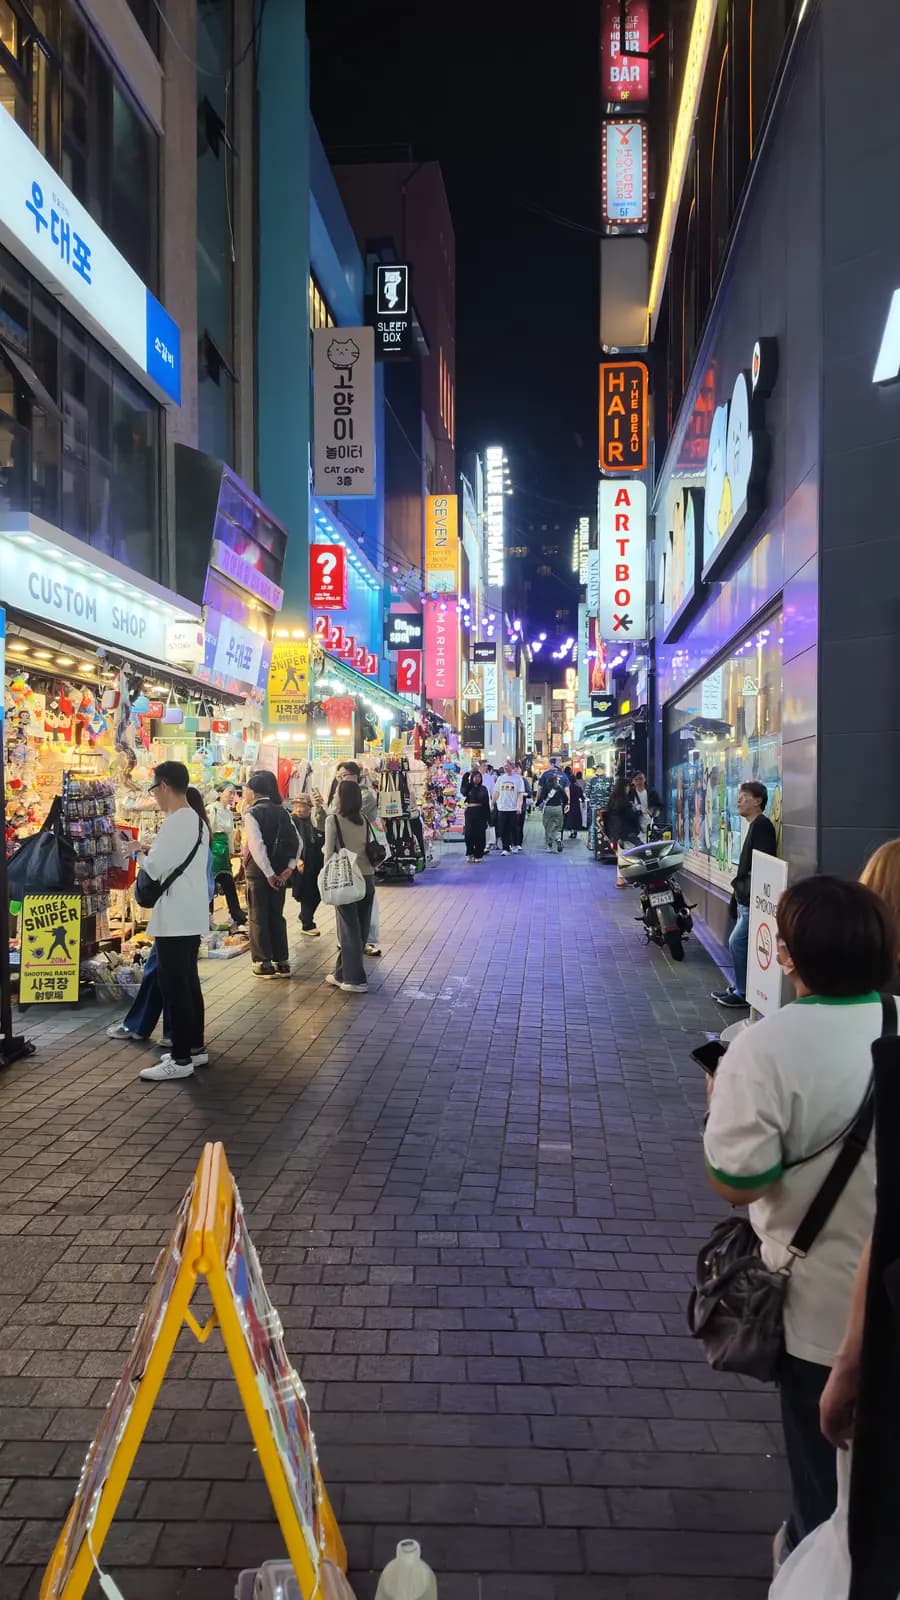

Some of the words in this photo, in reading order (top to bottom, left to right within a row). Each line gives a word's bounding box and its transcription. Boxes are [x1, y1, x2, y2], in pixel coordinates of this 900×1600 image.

[610, 65, 640, 82] BAR
[620, 207, 629, 217] 5F
[26, 182, 92, 285] 우대포
[377, 321, 408, 332] SLEEP
[383, 332, 402, 343] BOX
[155, 336, 174, 369] 소갈비
[333, 366, 354, 440] 고양이
[630, 379, 639, 409] THE
[606, 371, 626, 462] HAIR
[630, 413, 639, 453] BEAU
[326, 445, 363, 459] 놀이터
[324, 466, 341, 474] CAT
[344, 466, 365, 474] cafe
[336, 476, 353, 487] 3층
[434, 498, 448, 547] SEVEN
[612, 487, 633, 632] ARTBOX
[28, 571, 97, 623] CUSTOM
[112, 607, 147, 639] SHOP
[226, 636, 254, 671] 우대포
[271, 655, 307, 672] SNIPER
[763, 882, 771, 898] NO
[29, 899, 68, 917] KOREA
[24, 907, 79, 932] SNIPER
[31, 977, 69, 991] 사격장
